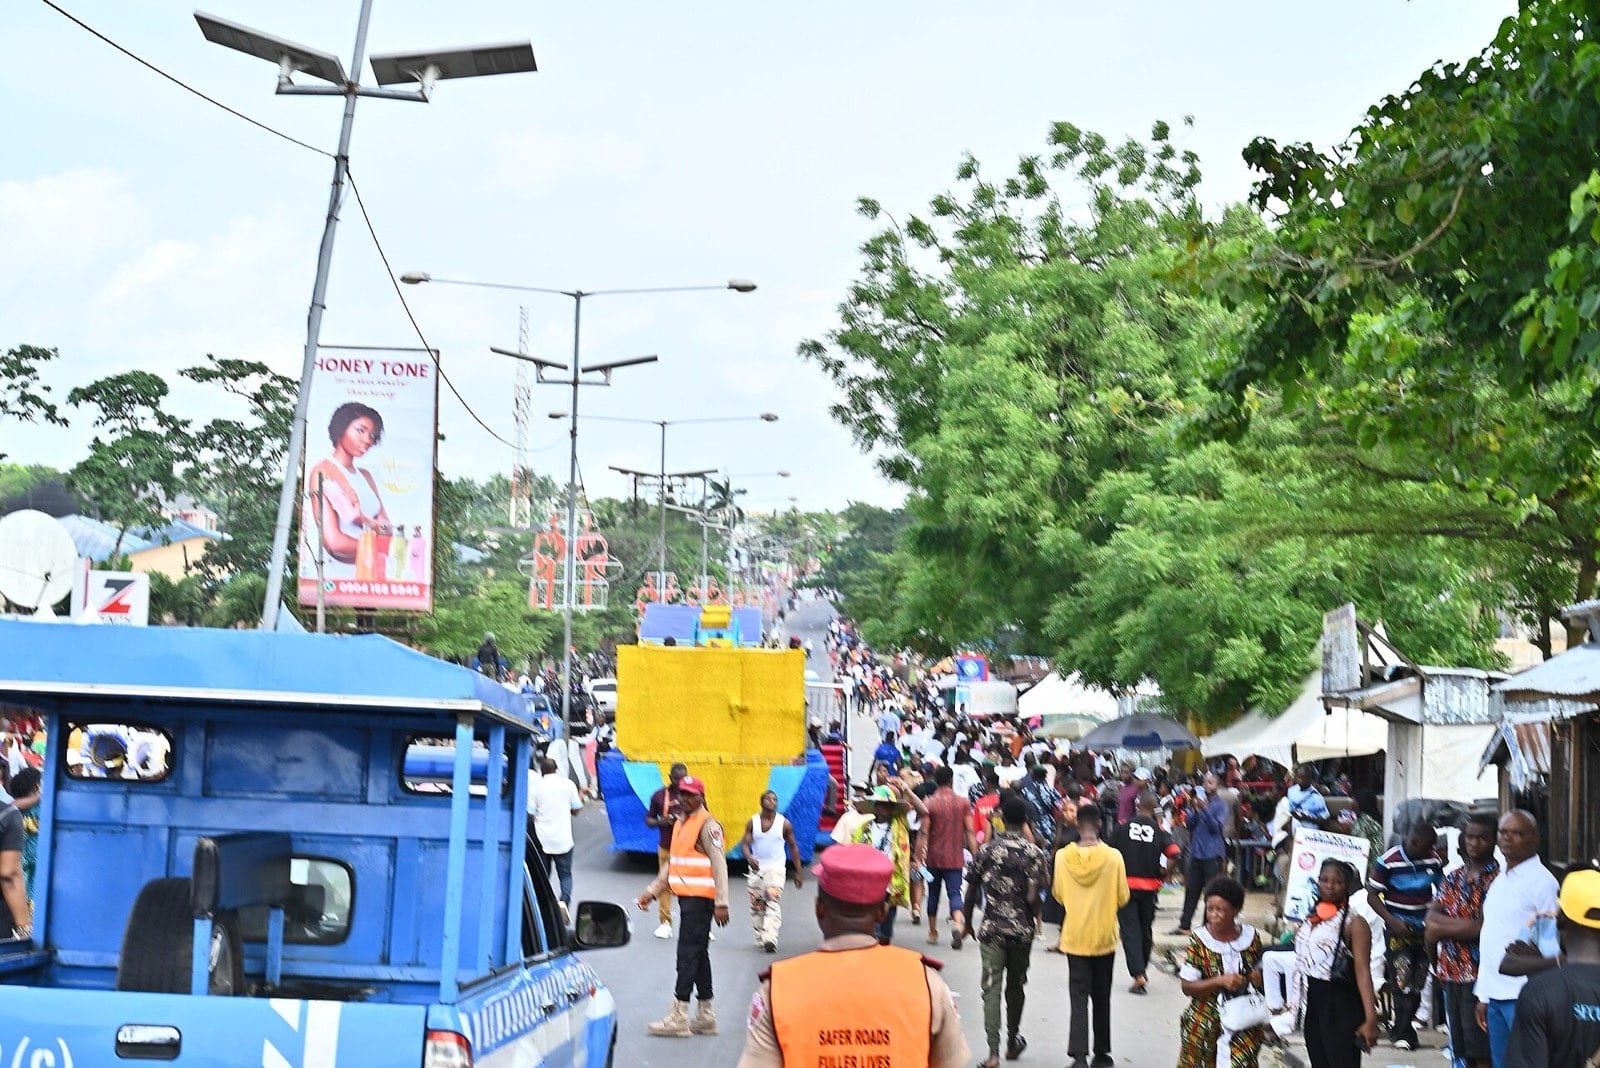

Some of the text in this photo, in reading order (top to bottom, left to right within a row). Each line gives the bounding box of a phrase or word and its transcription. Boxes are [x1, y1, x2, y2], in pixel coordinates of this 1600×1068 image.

[313, 358, 429, 378] HONEY TONE
[1129, 822, 1154, 843] 23
[819, 1030, 890, 1045] SAFER ROADS
[819, 1056, 890, 1068] FULLER LIVES
